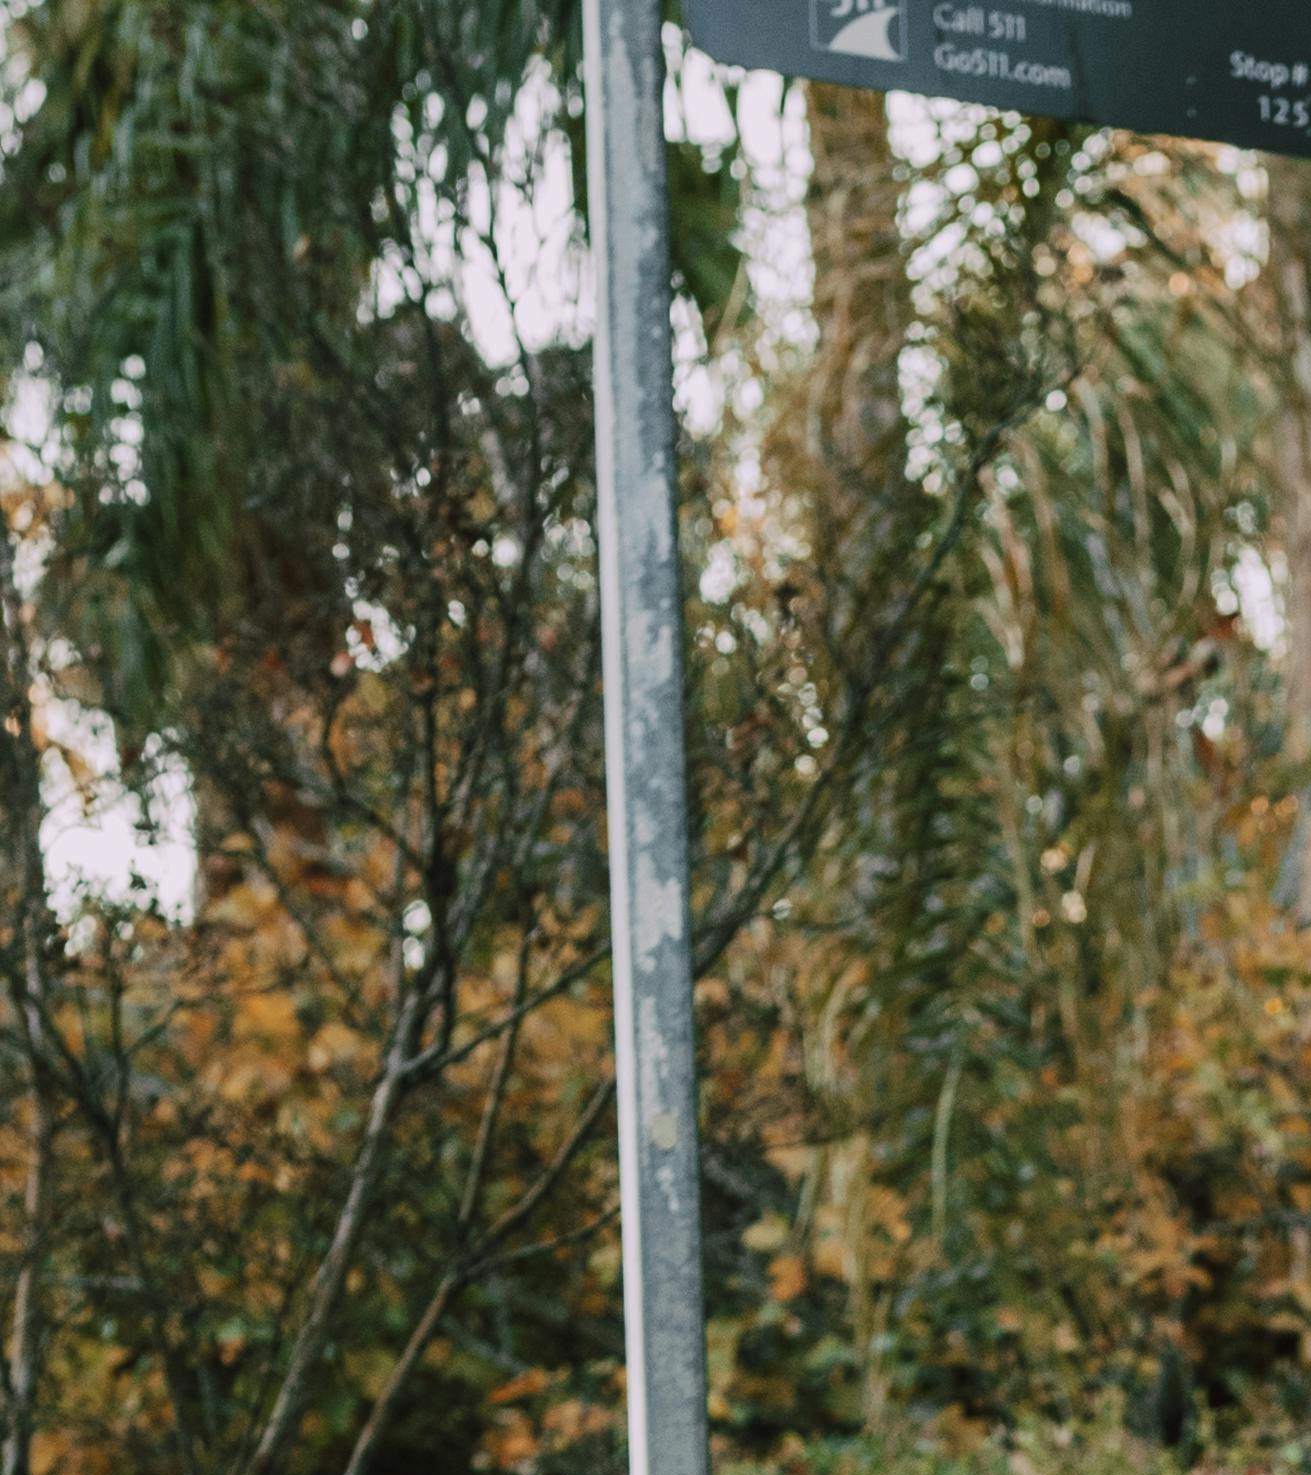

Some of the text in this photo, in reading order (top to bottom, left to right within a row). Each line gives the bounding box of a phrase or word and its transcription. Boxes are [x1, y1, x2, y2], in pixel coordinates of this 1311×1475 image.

[933, 3, 1027, 42] Call 511
[934, 42, 1071, 89] Go511.com
[1230, 51, 1309, 88] Stop #
[1258, 96, 1310, 127] 125
